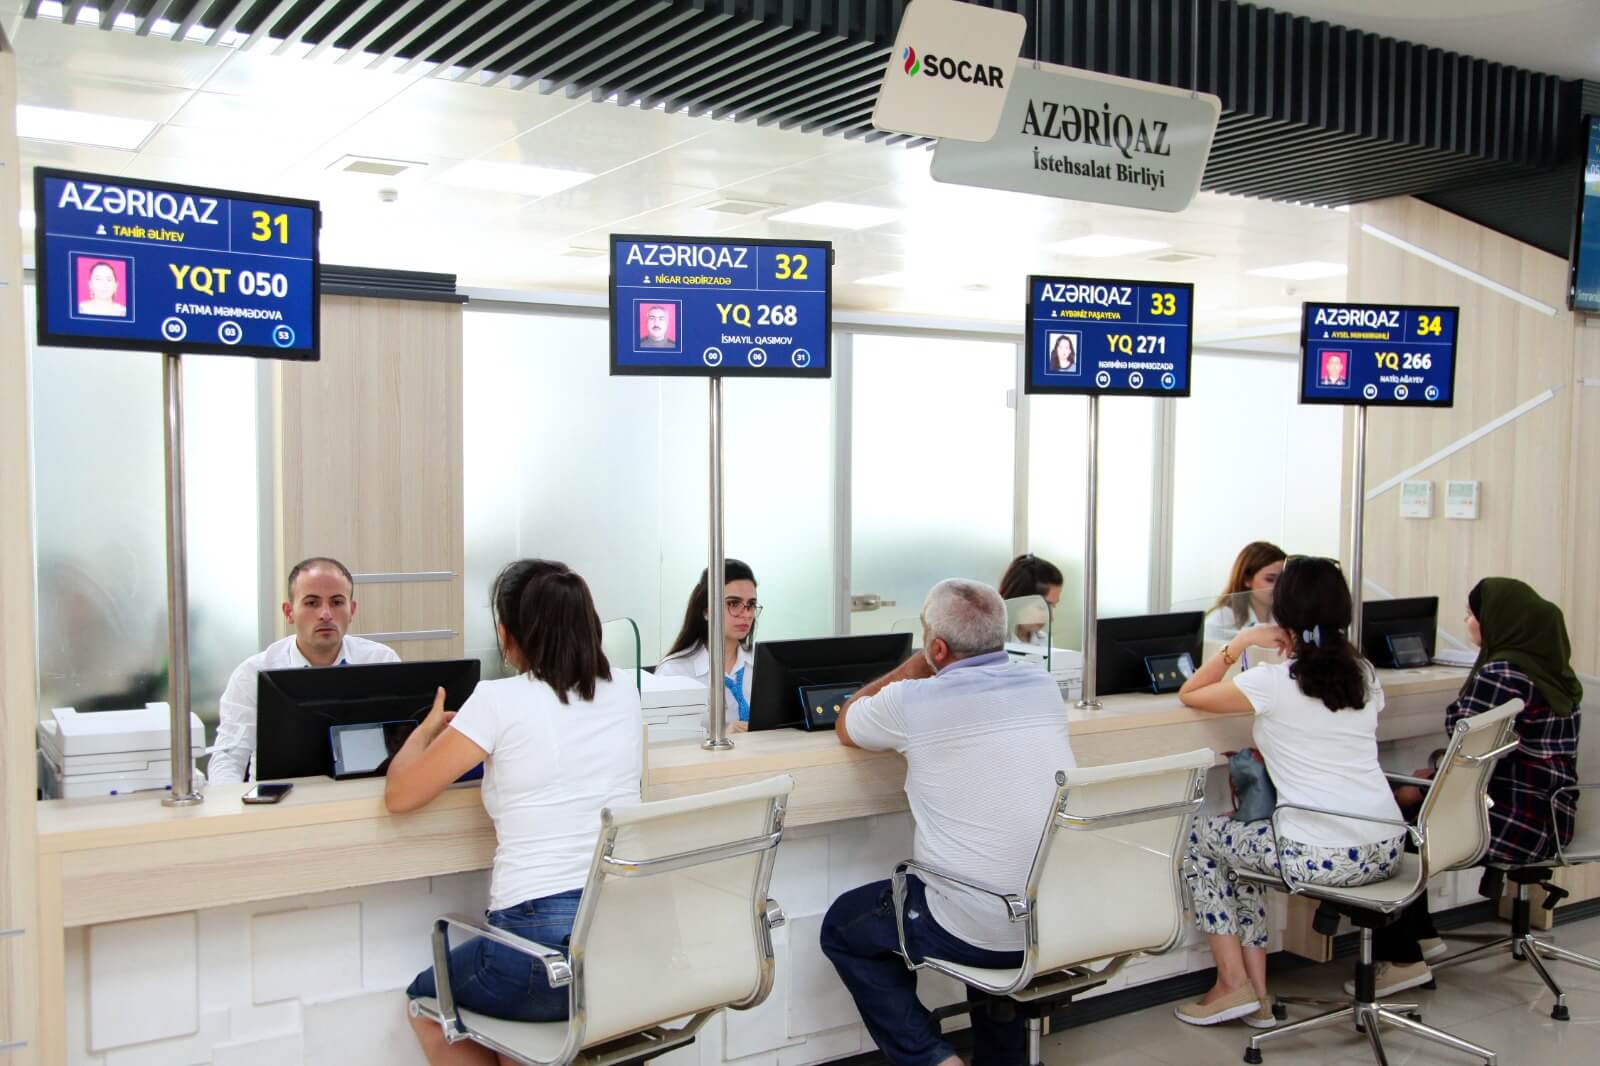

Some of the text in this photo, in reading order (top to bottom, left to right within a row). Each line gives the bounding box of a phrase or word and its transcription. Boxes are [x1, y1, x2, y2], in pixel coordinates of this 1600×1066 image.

[923, 54, 1004, 89] SOCAR
[1021, 98, 1171, 158] AZƏRİQAZ
[1032, 146, 1166, 191] İstehsalat Birliyi
[112, 225, 185, 242] TAHİR ƏLİYEV
[251, 210, 289, 244] 31
[775, 254, 808, 280] 32
[168, 264, 288, 298] YQT 050
[655, 275, 681, 285] NİGAR
[175, 303, 284, 321] FATMA MƏMMƏDOVA
[716, 303, 798, 328] YQ 268
[1151, 292, 1177, 316] 33
[1417, 315, 1442, 336] 34
[721, 333, 793, 346] İSMAYIL QASIMOV
[1106, 334, 1166, 355] YQ 271
[1375, 352, 1432, 371] YQ 266
